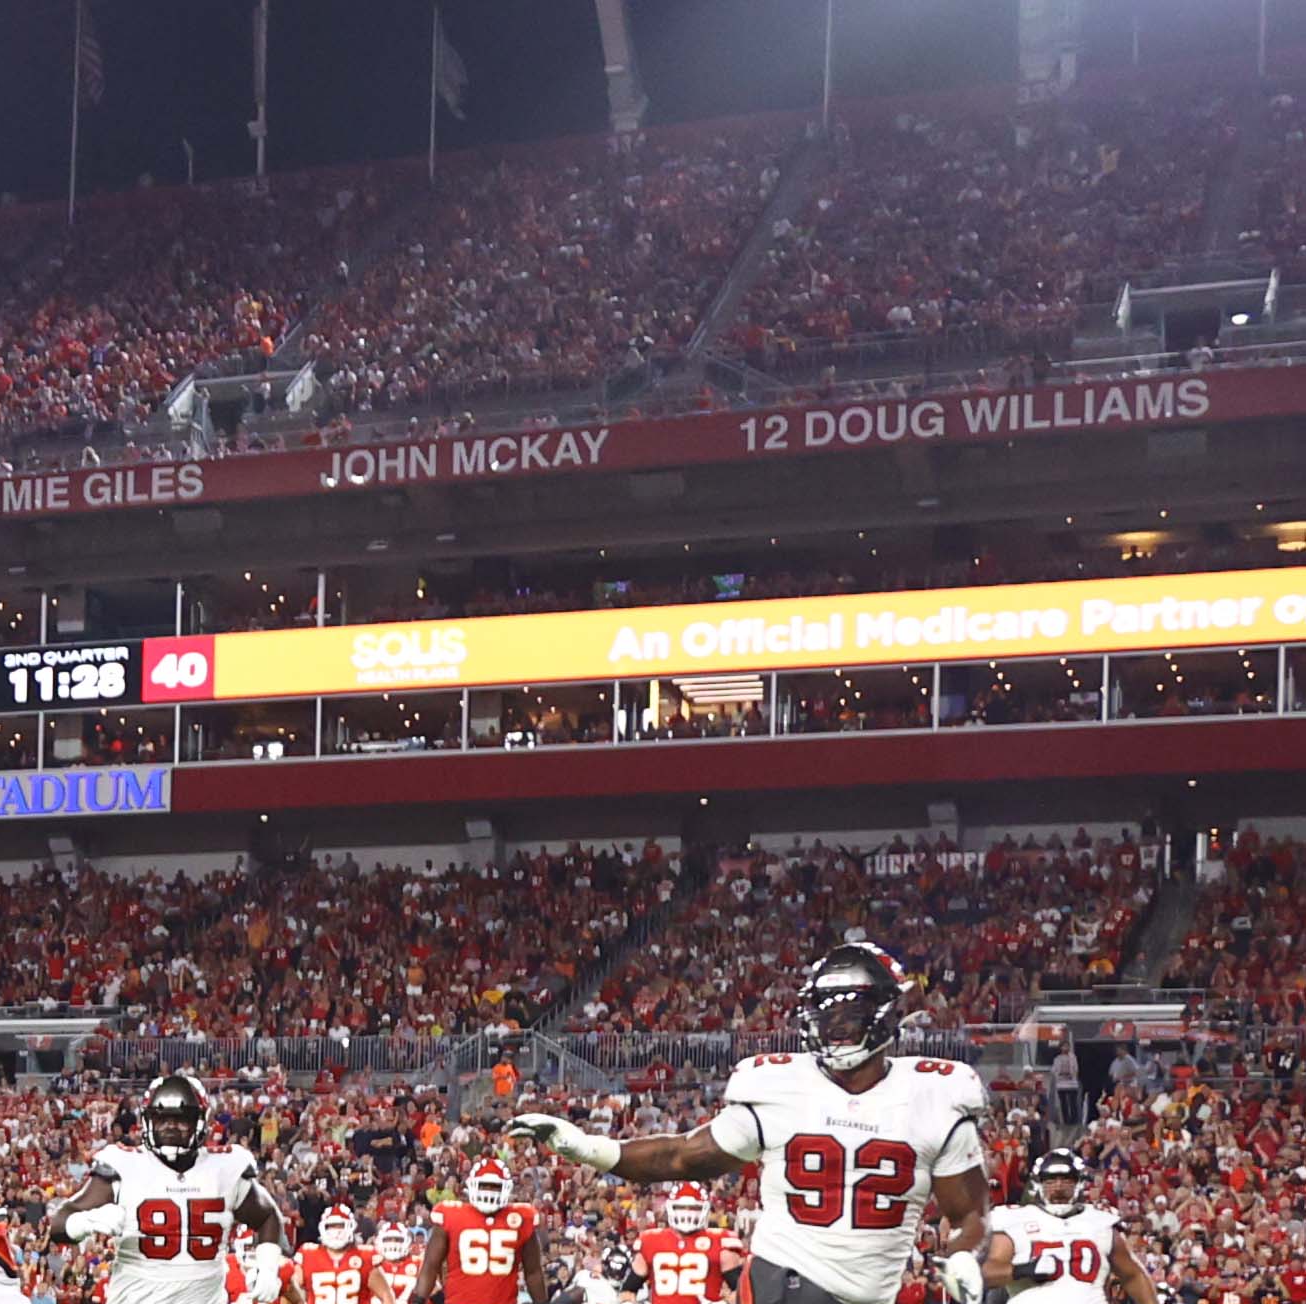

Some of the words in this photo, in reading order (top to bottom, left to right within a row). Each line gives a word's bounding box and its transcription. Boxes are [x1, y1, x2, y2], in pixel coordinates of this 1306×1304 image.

[740, 416, 789, 452] 12
[805, 400, 946, 447] DOUG
[961, 379, 1210, 435] WILLIAMS
[320, 443, 437, 487] JOHN
[452, 430, 609, 476] MCKAY
[83, 464, 205, 503] GILES
[608, 627, 670, 662] An
[680, 613, 844, 658] Official
[855, 605, 1067, 649] Medicare
[1080, 595, 1263, 635] Partner
[1273, 594, 1306, 624] o
[4, 652, 41, 668] 2ND
[43, 646, 129, 664] QUARTER
[149, 653, 208, 689] 40
[9, 664, 125, 703] 11:28
[784, 1132, 917, 1229] 92
[137, 1198, 226, 1261] 95
[459, 1229, 518, 1276] 65
[653, 1252, 708, 1296] 62
[1030, 1239, 1101, 1283] 50
